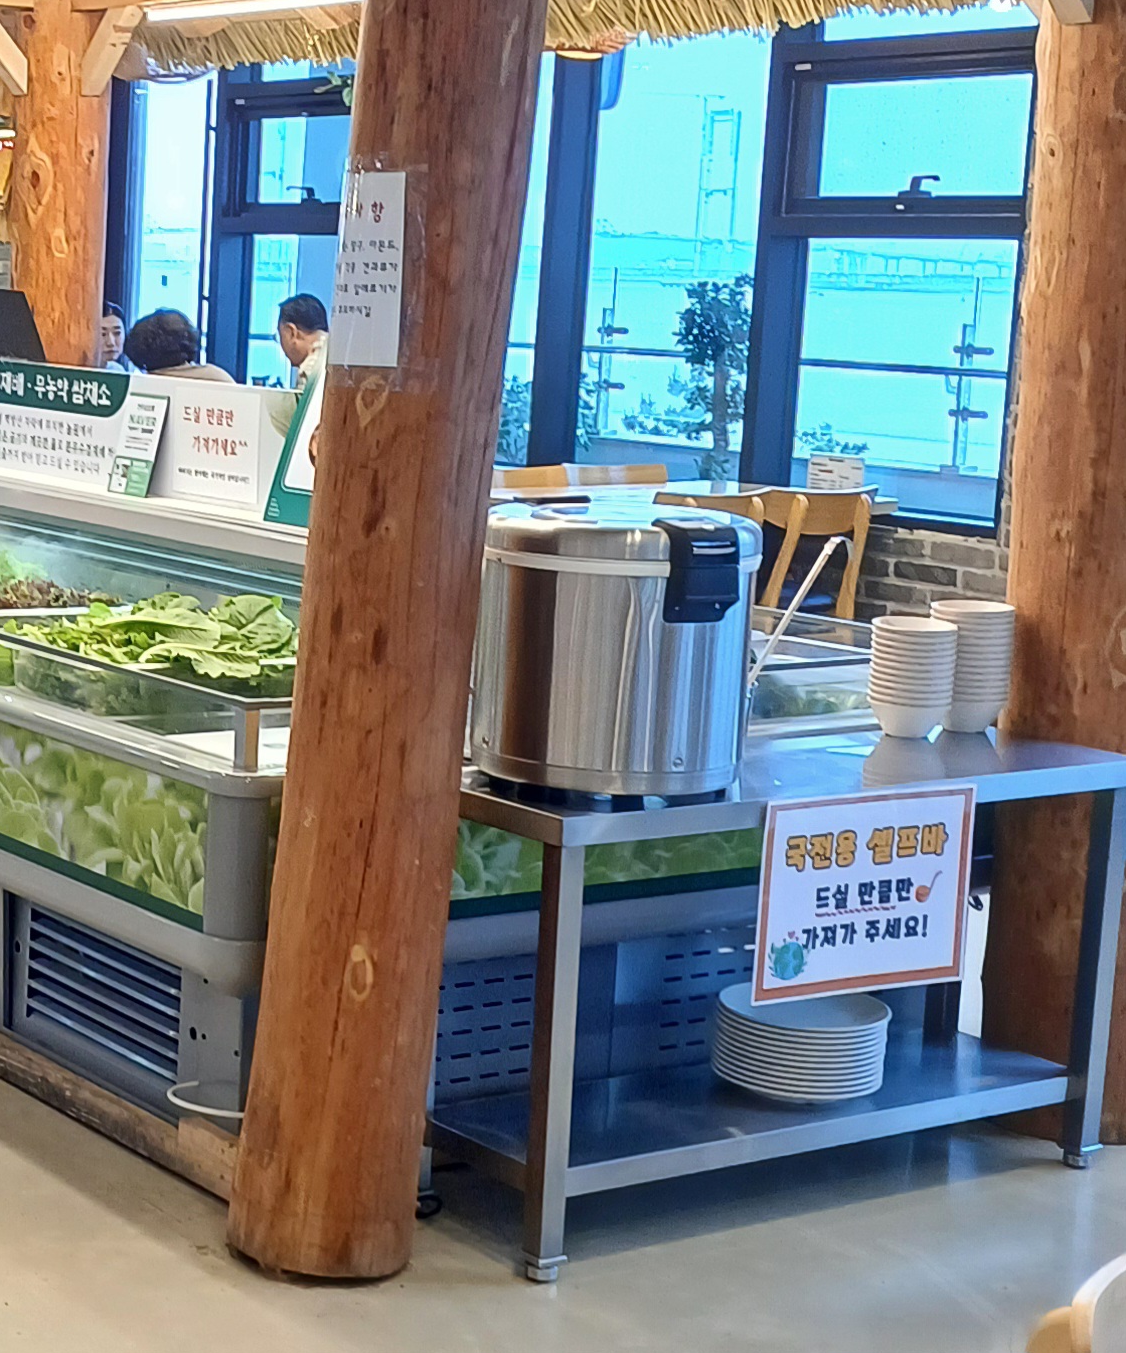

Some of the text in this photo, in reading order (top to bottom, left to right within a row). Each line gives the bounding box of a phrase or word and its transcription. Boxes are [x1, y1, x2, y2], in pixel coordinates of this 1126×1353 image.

[34, 373, 70, 403] 무농약
[71, 379, 112, 406] 쌈채소
[183, 406, 234, 428] 드실 만큼만
[786, 822, 949, 872] 국전용 셀프바
[815, 877, 914, 909] 드실 만큼만
[801, 914, 929, 950] 가져가 주세요!
